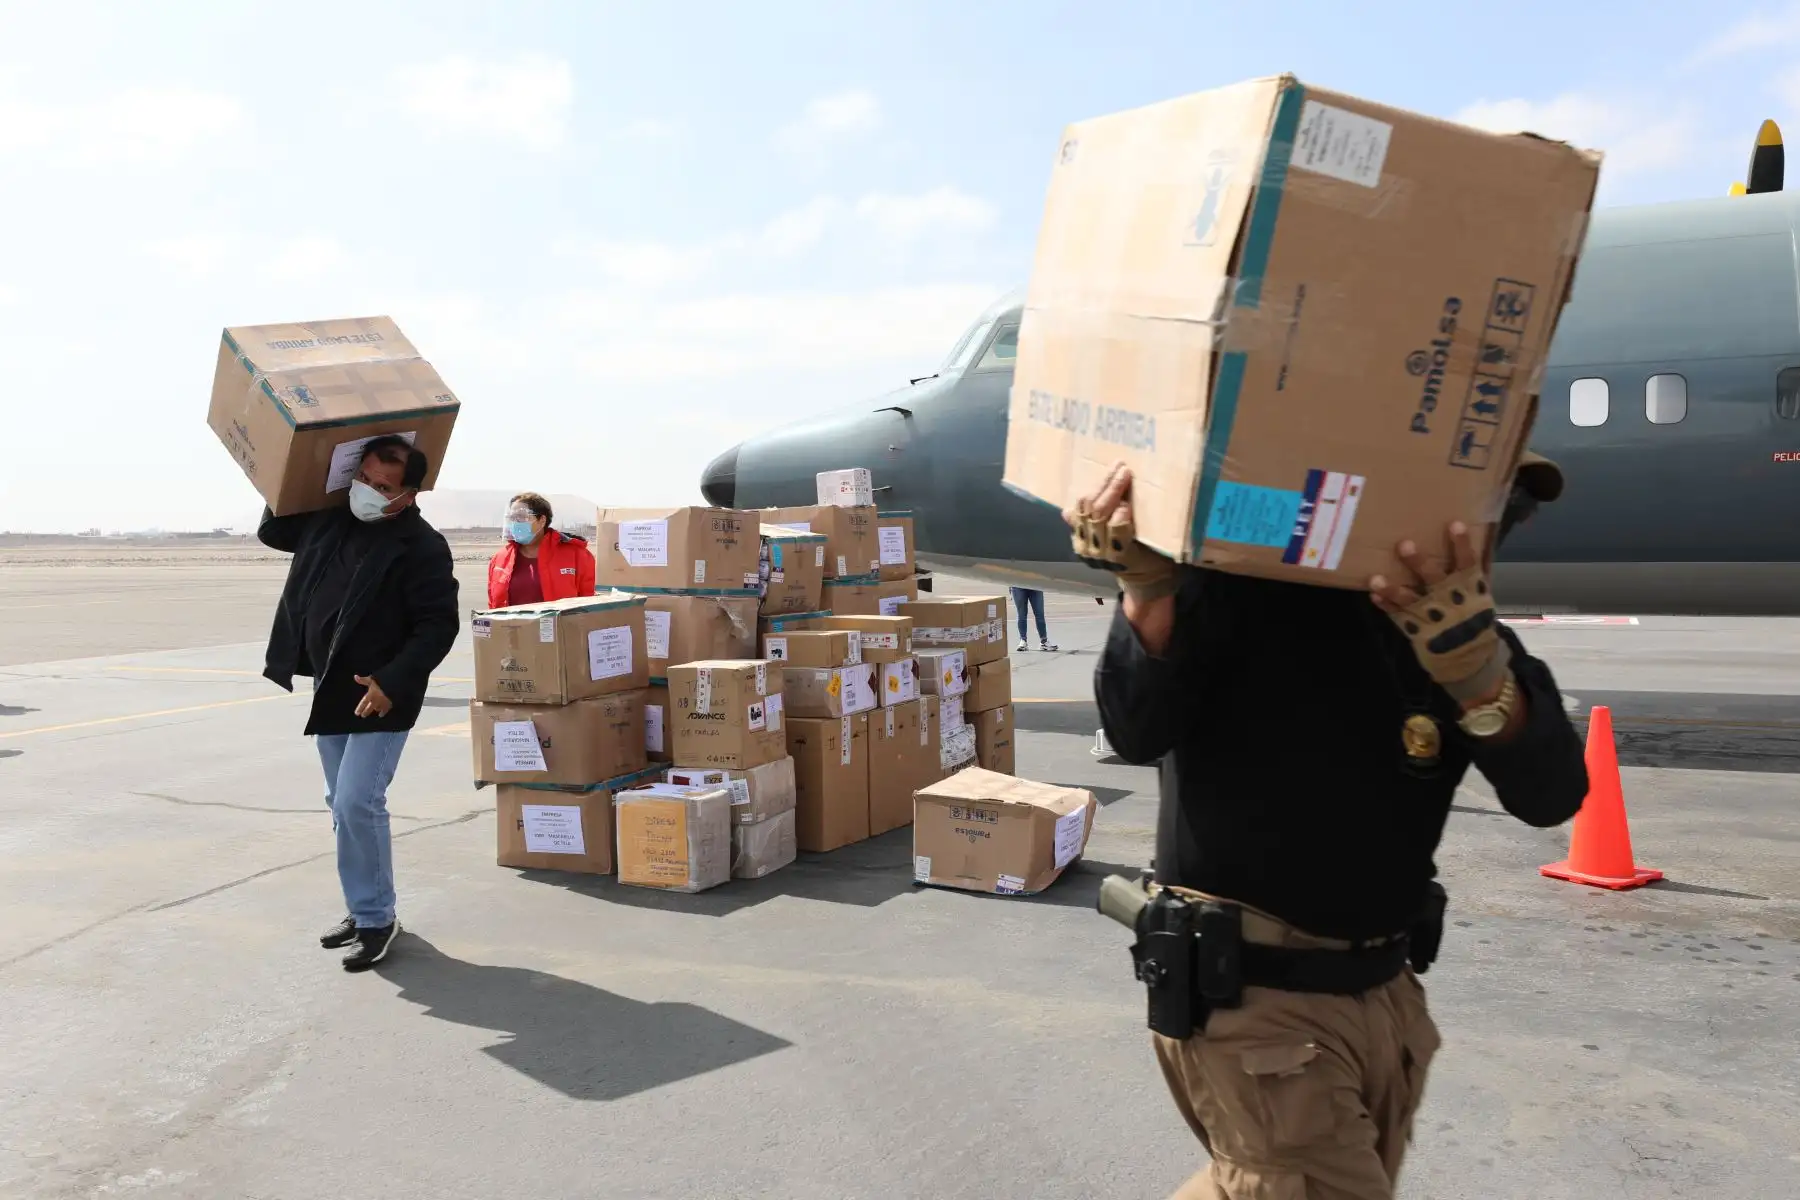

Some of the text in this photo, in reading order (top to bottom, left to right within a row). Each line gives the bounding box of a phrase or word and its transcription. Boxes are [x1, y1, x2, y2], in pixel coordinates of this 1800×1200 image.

[352, 332, 385, 345] ESTE
[1409, 296, 1462, 433] Pamolsa
[1093, 404, 1157, 452] ARRIBA
[1293, 498, 1315, 537] PET
[687, 712, 726, 721] ADVANCE
